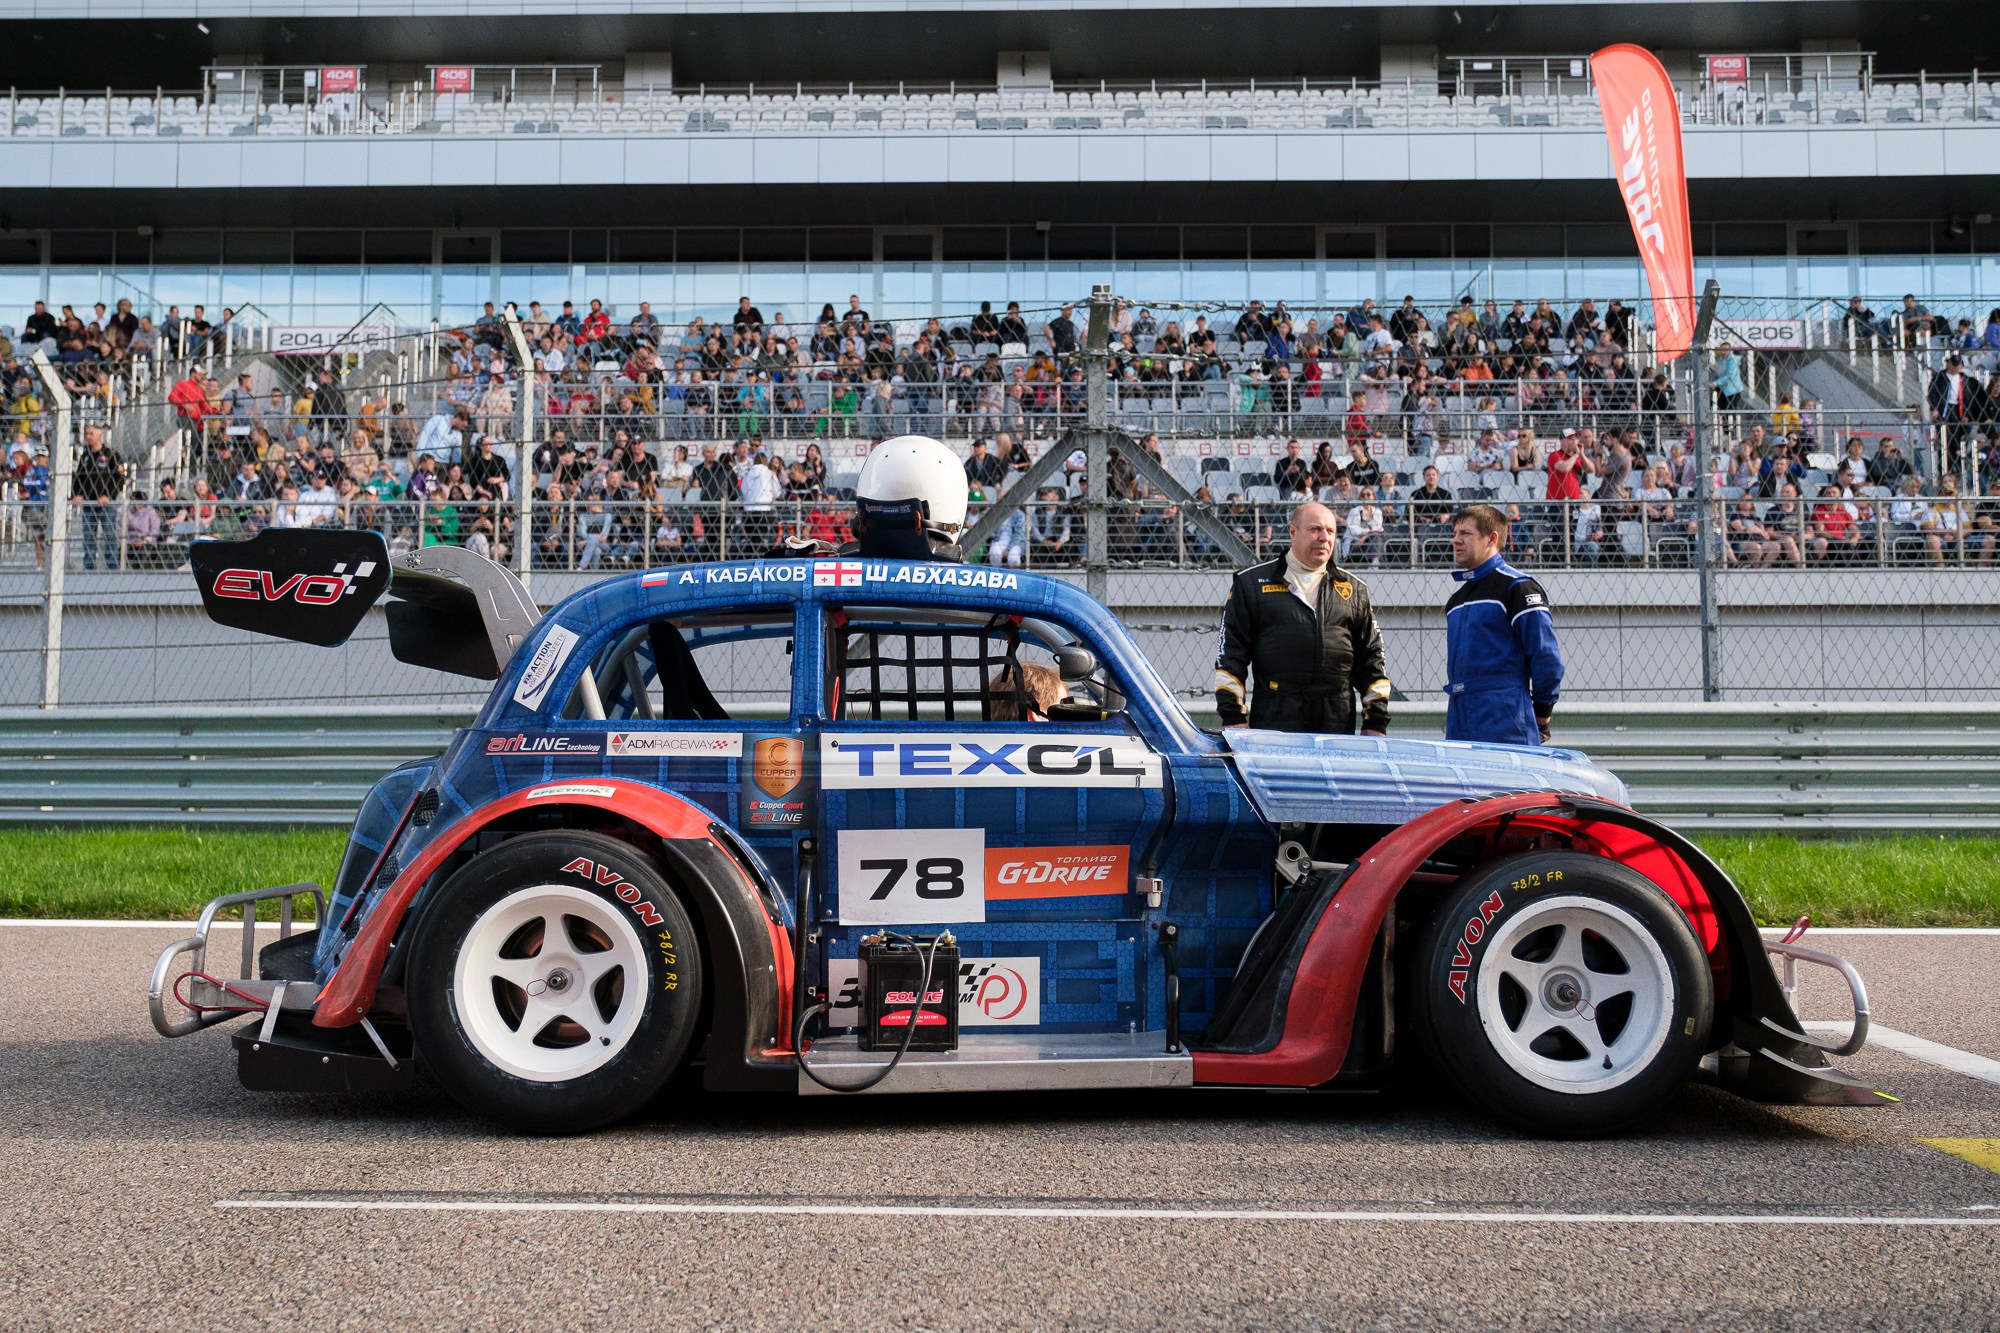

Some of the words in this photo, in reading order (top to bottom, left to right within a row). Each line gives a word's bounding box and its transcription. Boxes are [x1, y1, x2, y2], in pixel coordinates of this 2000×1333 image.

[1712, 59, 1742, 69] 406
[326, 69, 354, 80] 404
[279, 332, 323, 347] 204
[1747, 326, 1794, 341] 206
[678, 571, 699, 585] А.
[706, 566, 807, 584] КАБАКОВ
[212, 568, 346, 606] EVO
[528, 675, 539, 688] FOR
[535, 659, 551, 679] ROAD
[546, 632, 566, 660] SAFETY
[530, 640, 553, 673] ACTION
[837, 743, 1147, 777] TEXOL
[759, 768, 797, 777] CUPPER
[532, 787, 601, 797] SPECTRUM
[1056, 855, 1118, 864] ТОПЛИВО
[859, 857, 965, 901] 78
[1511, 874, 1541, 892] 78/2
[1546, 870, 1563, 882] FR
[559, 856, 665, 927] AVON
[658, 929, 677, 965] 78/2
[1448, 889, 1505, 1006] AVON
[664, 972, 678, 991] RR
[885, 991, 943, 1004] SOLTE
